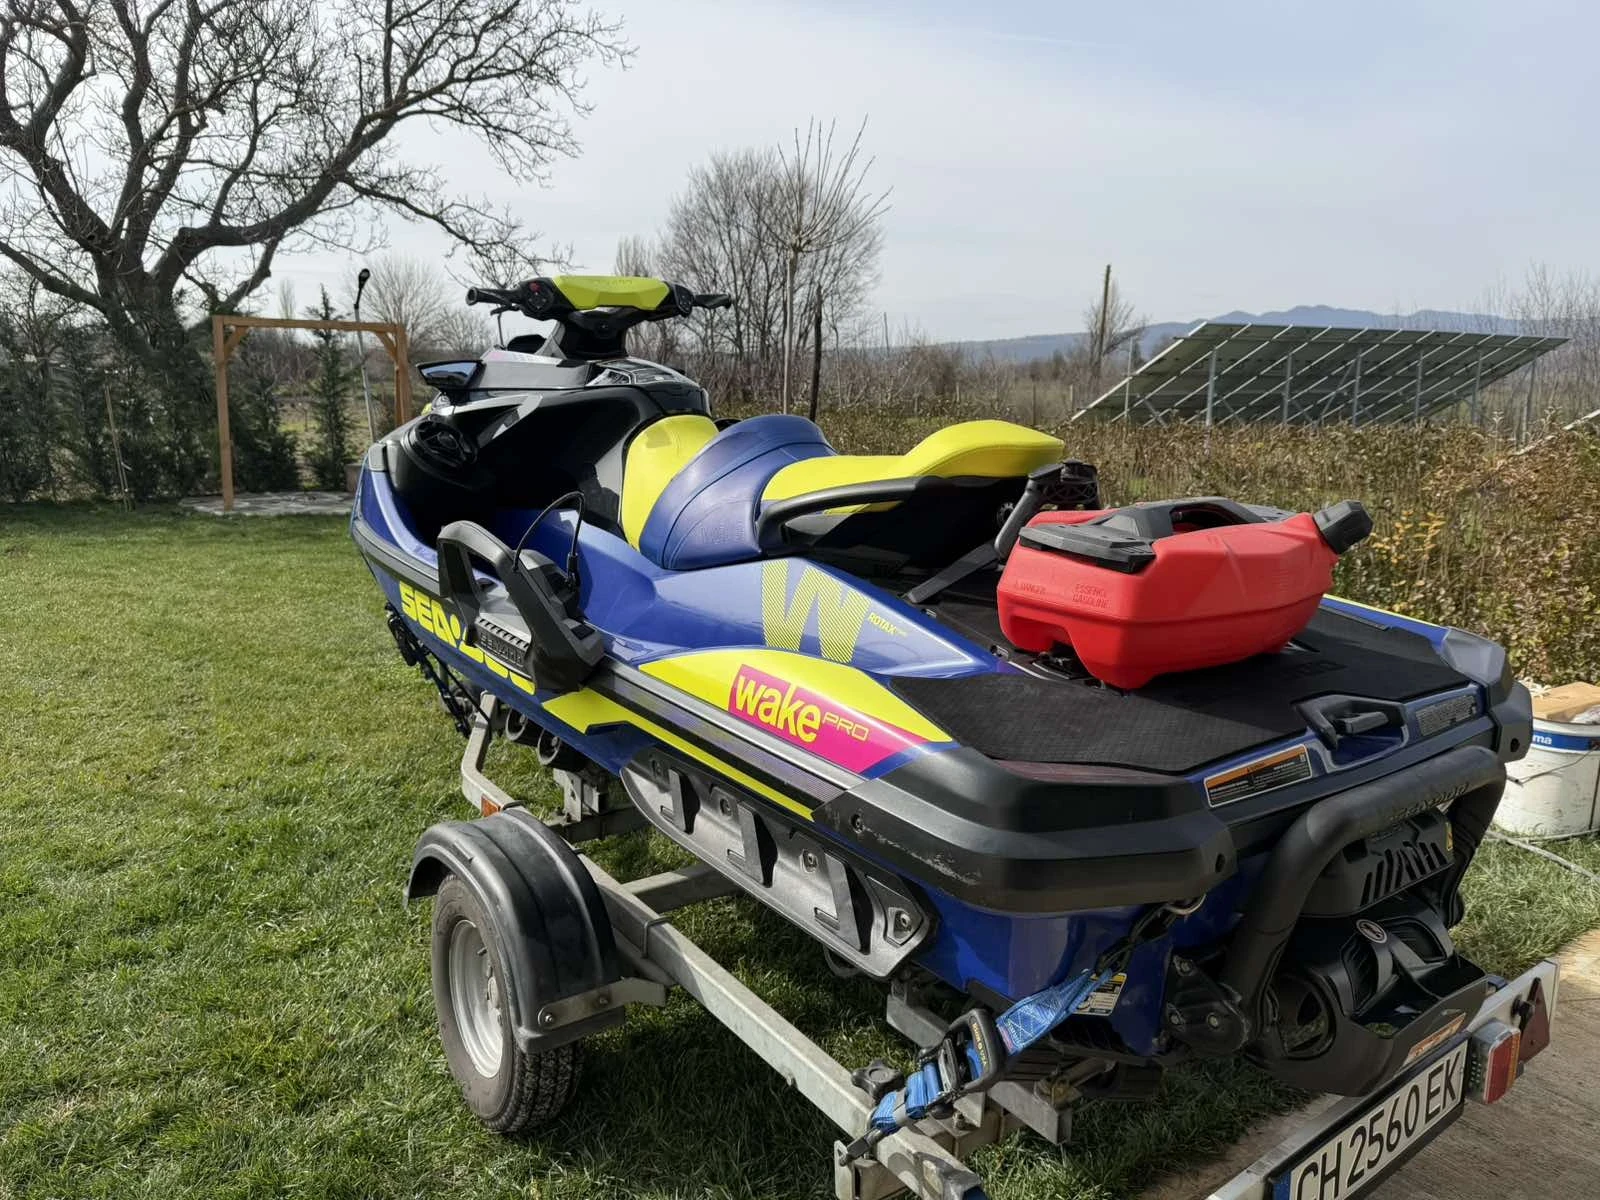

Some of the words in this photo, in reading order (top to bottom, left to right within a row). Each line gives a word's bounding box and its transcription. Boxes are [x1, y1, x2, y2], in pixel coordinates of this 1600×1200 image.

[867, 612, 898, 636] ROTAX
[735, 674, 821, 743] wake
[822, 711, 869, 742] PRO
